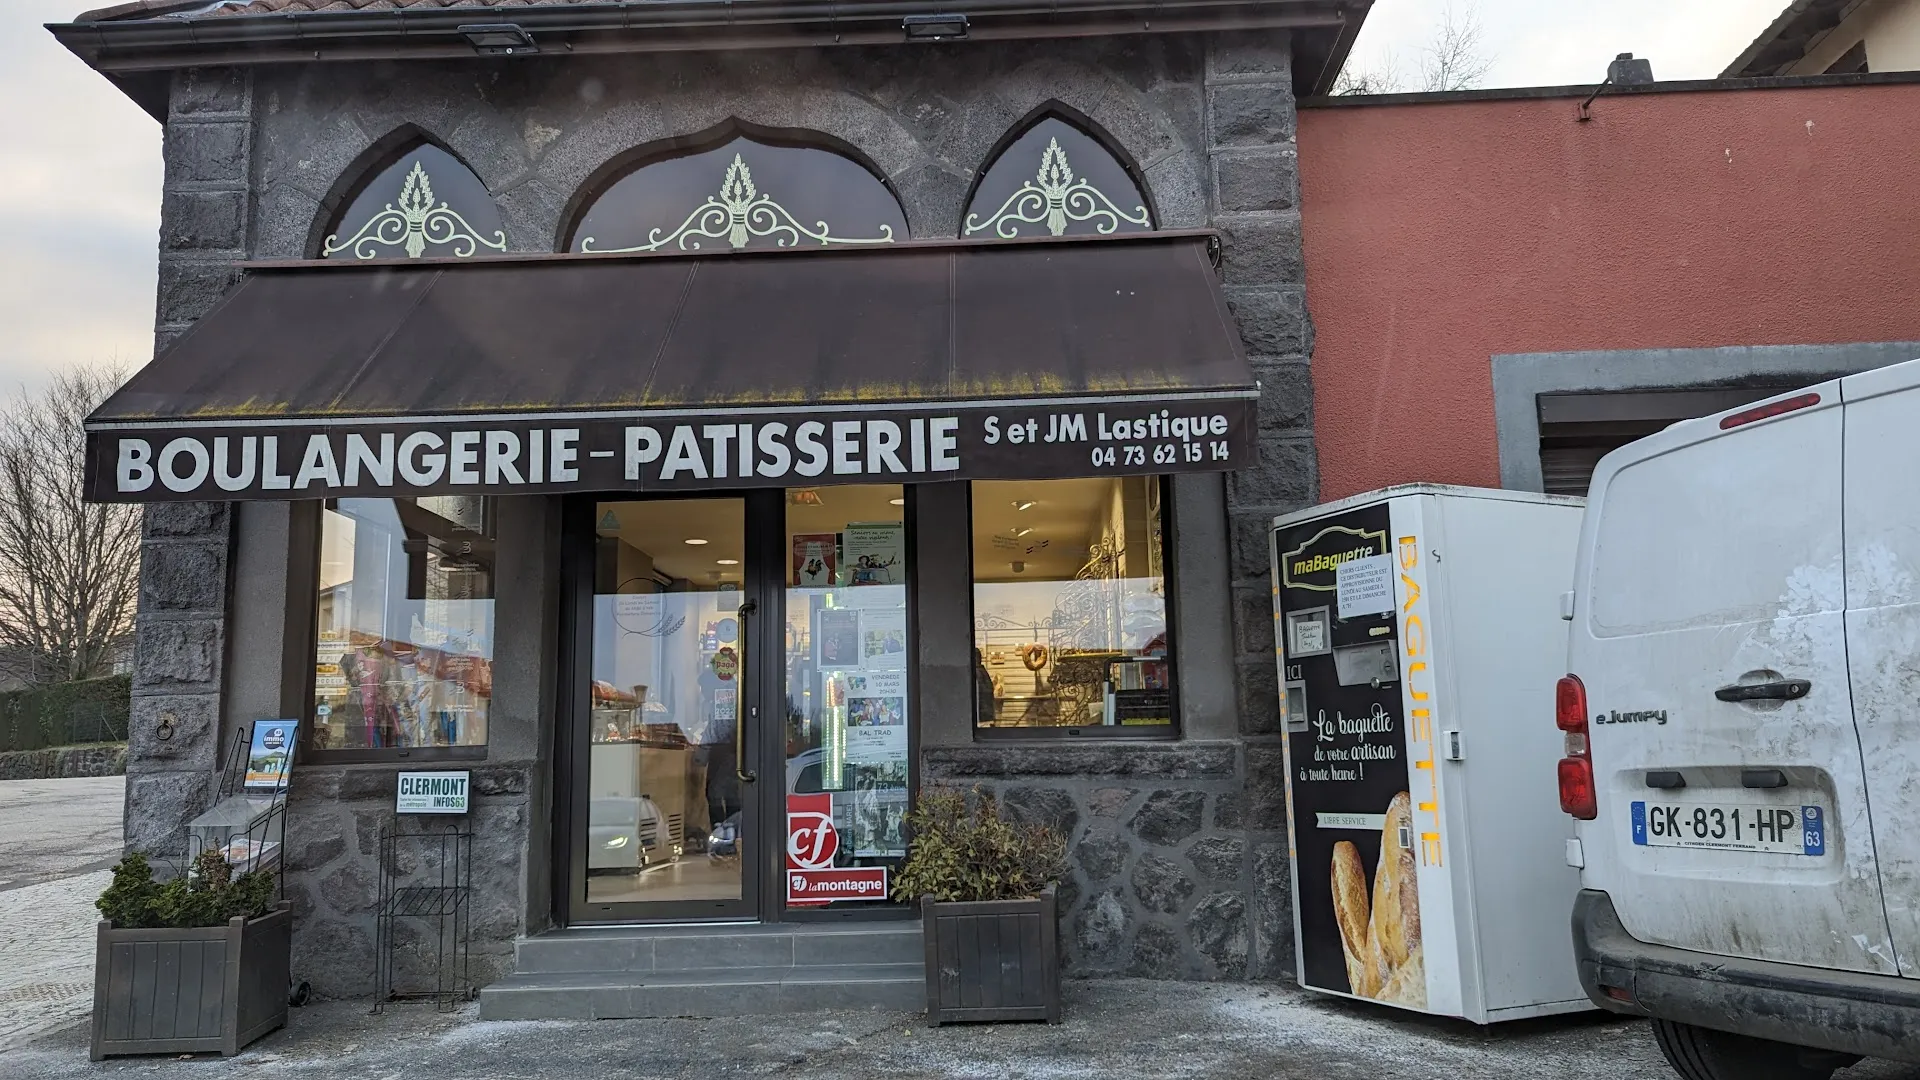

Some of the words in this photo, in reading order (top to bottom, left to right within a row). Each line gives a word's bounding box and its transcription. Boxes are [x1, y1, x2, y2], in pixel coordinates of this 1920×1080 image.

[983, 416, 1001, 445] S
[1006, 420, 1038, 444] et
[1043, 414, 1089, 443] JM
[1097, 410, 1229, 443] Lastique
[116, 428, 580, 493] BOULANGERIE
[623, 416, 960, 481] PATISSERIE
[1090, 446, 1116, 467] 04
[1122, 444, 1146, 466] 73
[1152, 443, 1177, 465] 62
[1183, 442, 1204, 463] 15
[1209, 441, 1230, 462] 14
[1293, 545, 1374, 577] maBaguette
[1287, 664, 1302, 680] ICI
[1398, 535, 1444, 868] BAGUETTE
[1312, 708, 1336, 741] La
[1338, 702, 1394, 743] baguette
[1314, 744, 1326, 762] de
[1327, 747, 1350, 762] votre
[1351, 743, 1396, 761] artisan
[1300, 766, 1307, 781] à
[1309, 766, 1330, 781] toute
[1331, 764, 1357, 781] heure
[400, 777, 466, 796] CLERMONT
[433, 796, 465, 808] INFOS63
[1323, 816, 1340, 825] LIBRE
[1341, 817, 1367, 826] SERVICE
[1636, 824, 1642, 836] F
[1649, 805, 1795, 844] GK-831-HP
[1805, 830, 1821, 848] 63
